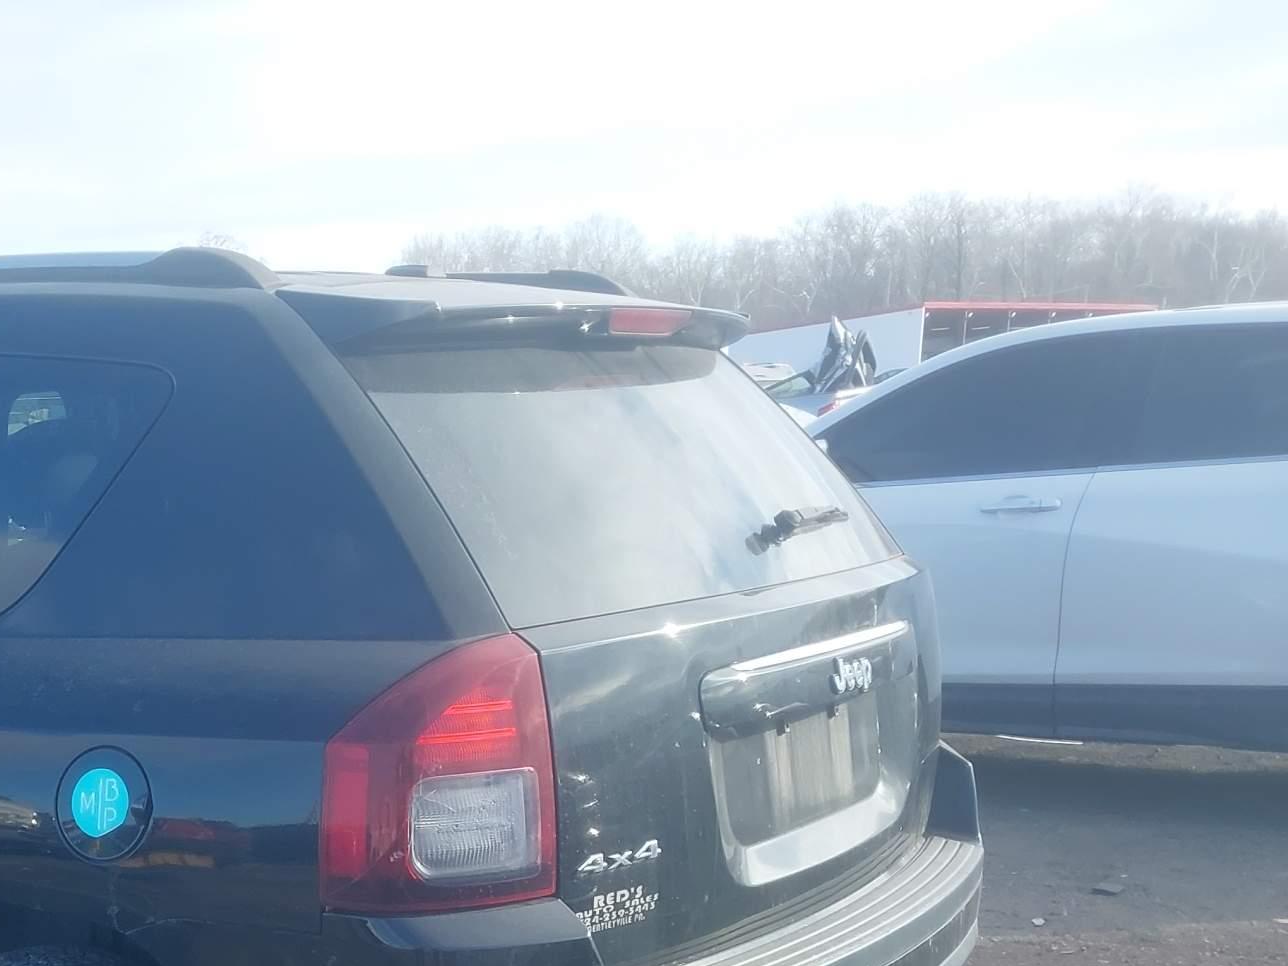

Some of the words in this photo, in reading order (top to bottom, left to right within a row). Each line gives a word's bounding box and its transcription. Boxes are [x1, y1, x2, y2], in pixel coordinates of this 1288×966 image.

[832, 657, 872, 693] Jeep
[577, 839, 662, 872] 4x4
[593, 885, 643, 908] RED'S
[624, 893, 659, 908] SALES
